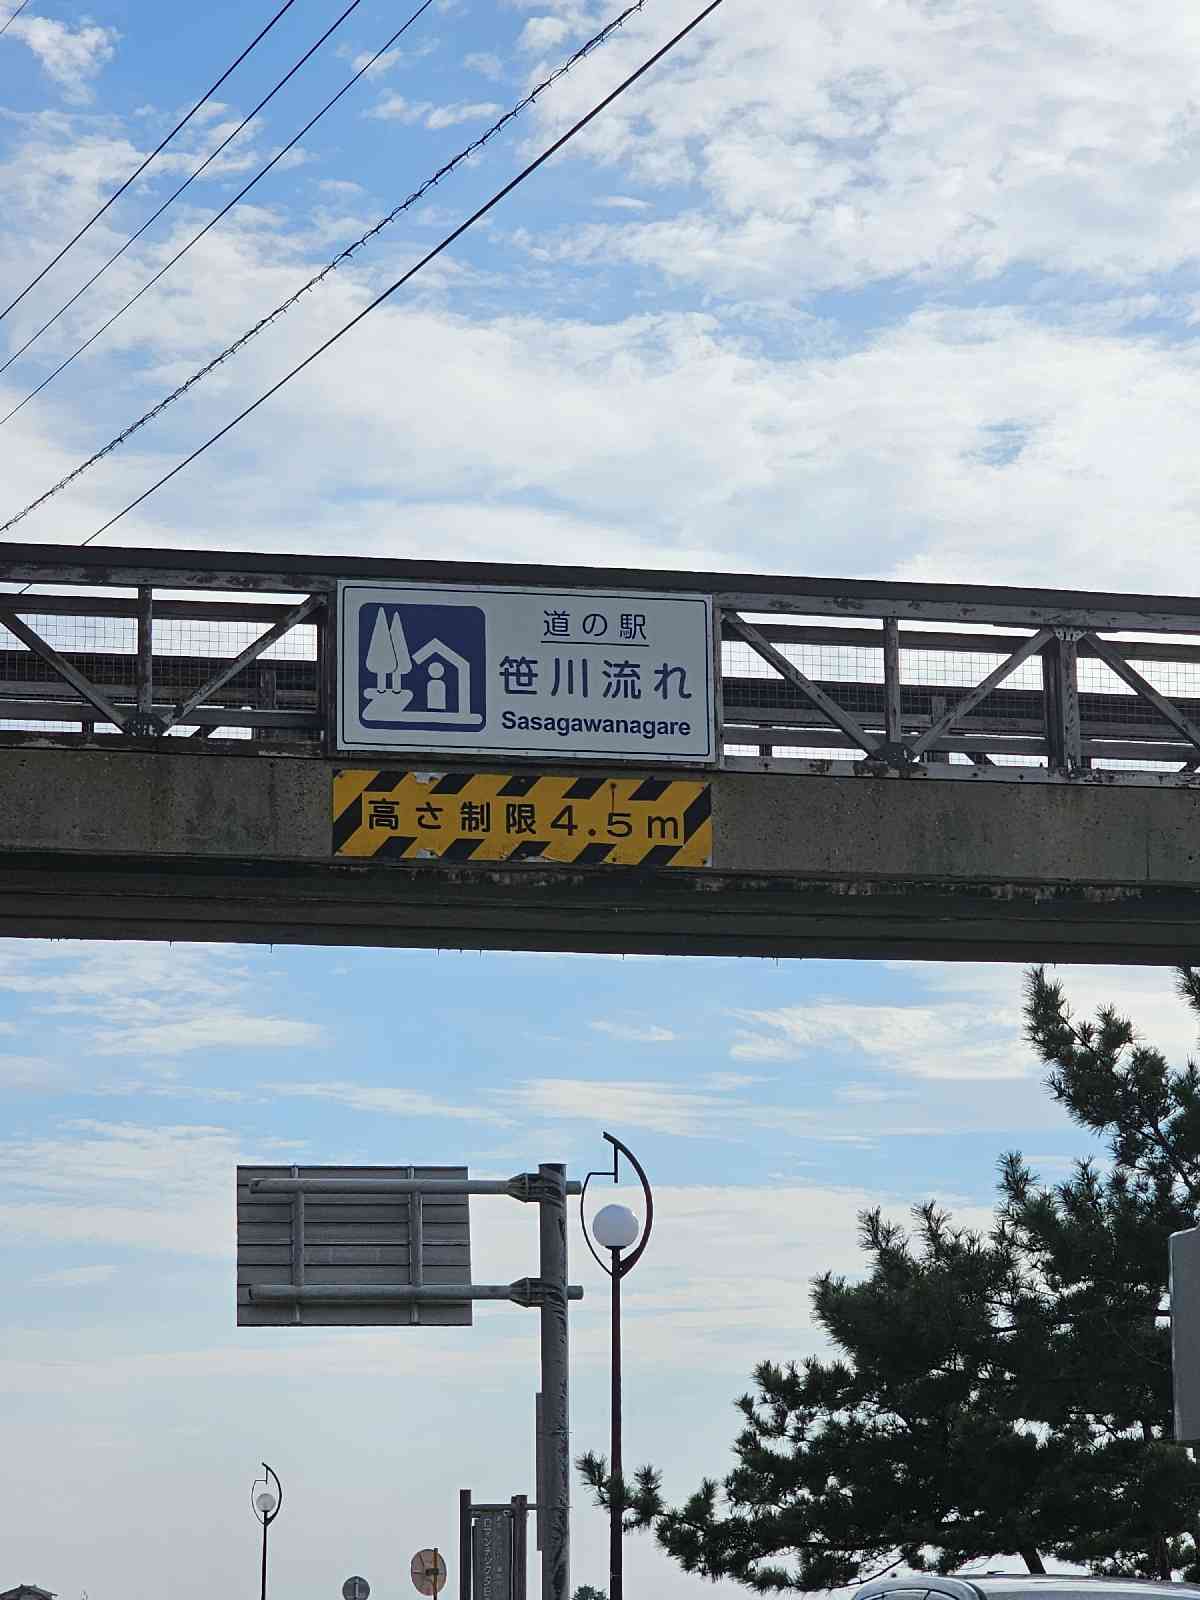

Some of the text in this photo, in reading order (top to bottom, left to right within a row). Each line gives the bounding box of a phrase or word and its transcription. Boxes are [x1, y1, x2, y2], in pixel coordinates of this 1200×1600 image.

[543, 610, 647, 640] 道の駅
[499, 655, 692, 700] 笹川流れ
[501, 711, 692, 739] Sasagawanagare
